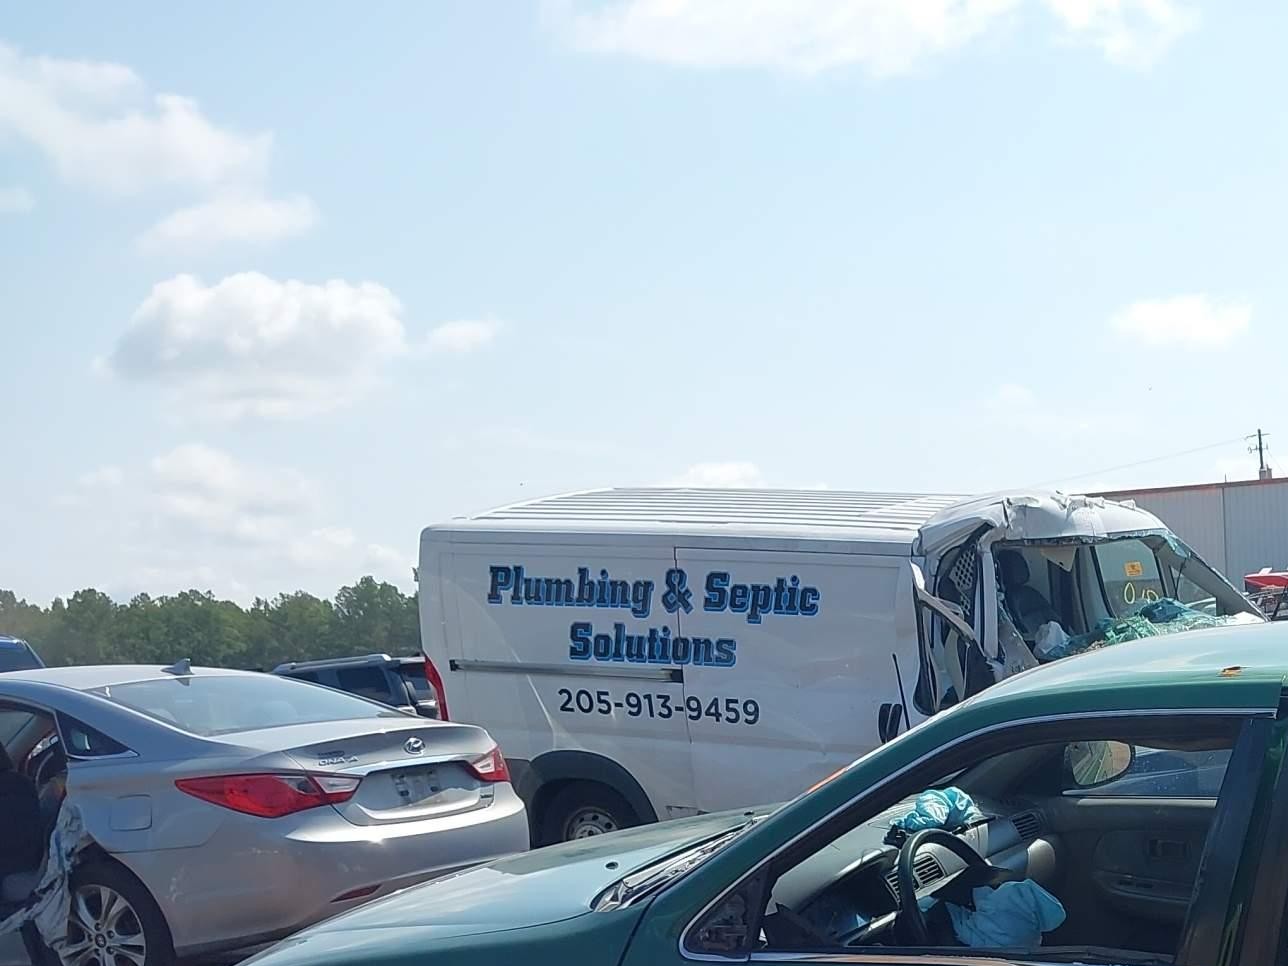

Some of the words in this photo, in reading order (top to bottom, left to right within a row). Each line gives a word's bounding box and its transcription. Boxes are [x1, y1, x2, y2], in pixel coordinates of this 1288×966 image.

[487, 565, 655, 619] Plumbing
[661, 567, 695, 615] &
[703, 571, 821, 625] Septic
[569, 621, 737, 667] Solutions
[557, 687, 761, 726] 205-913-9459
